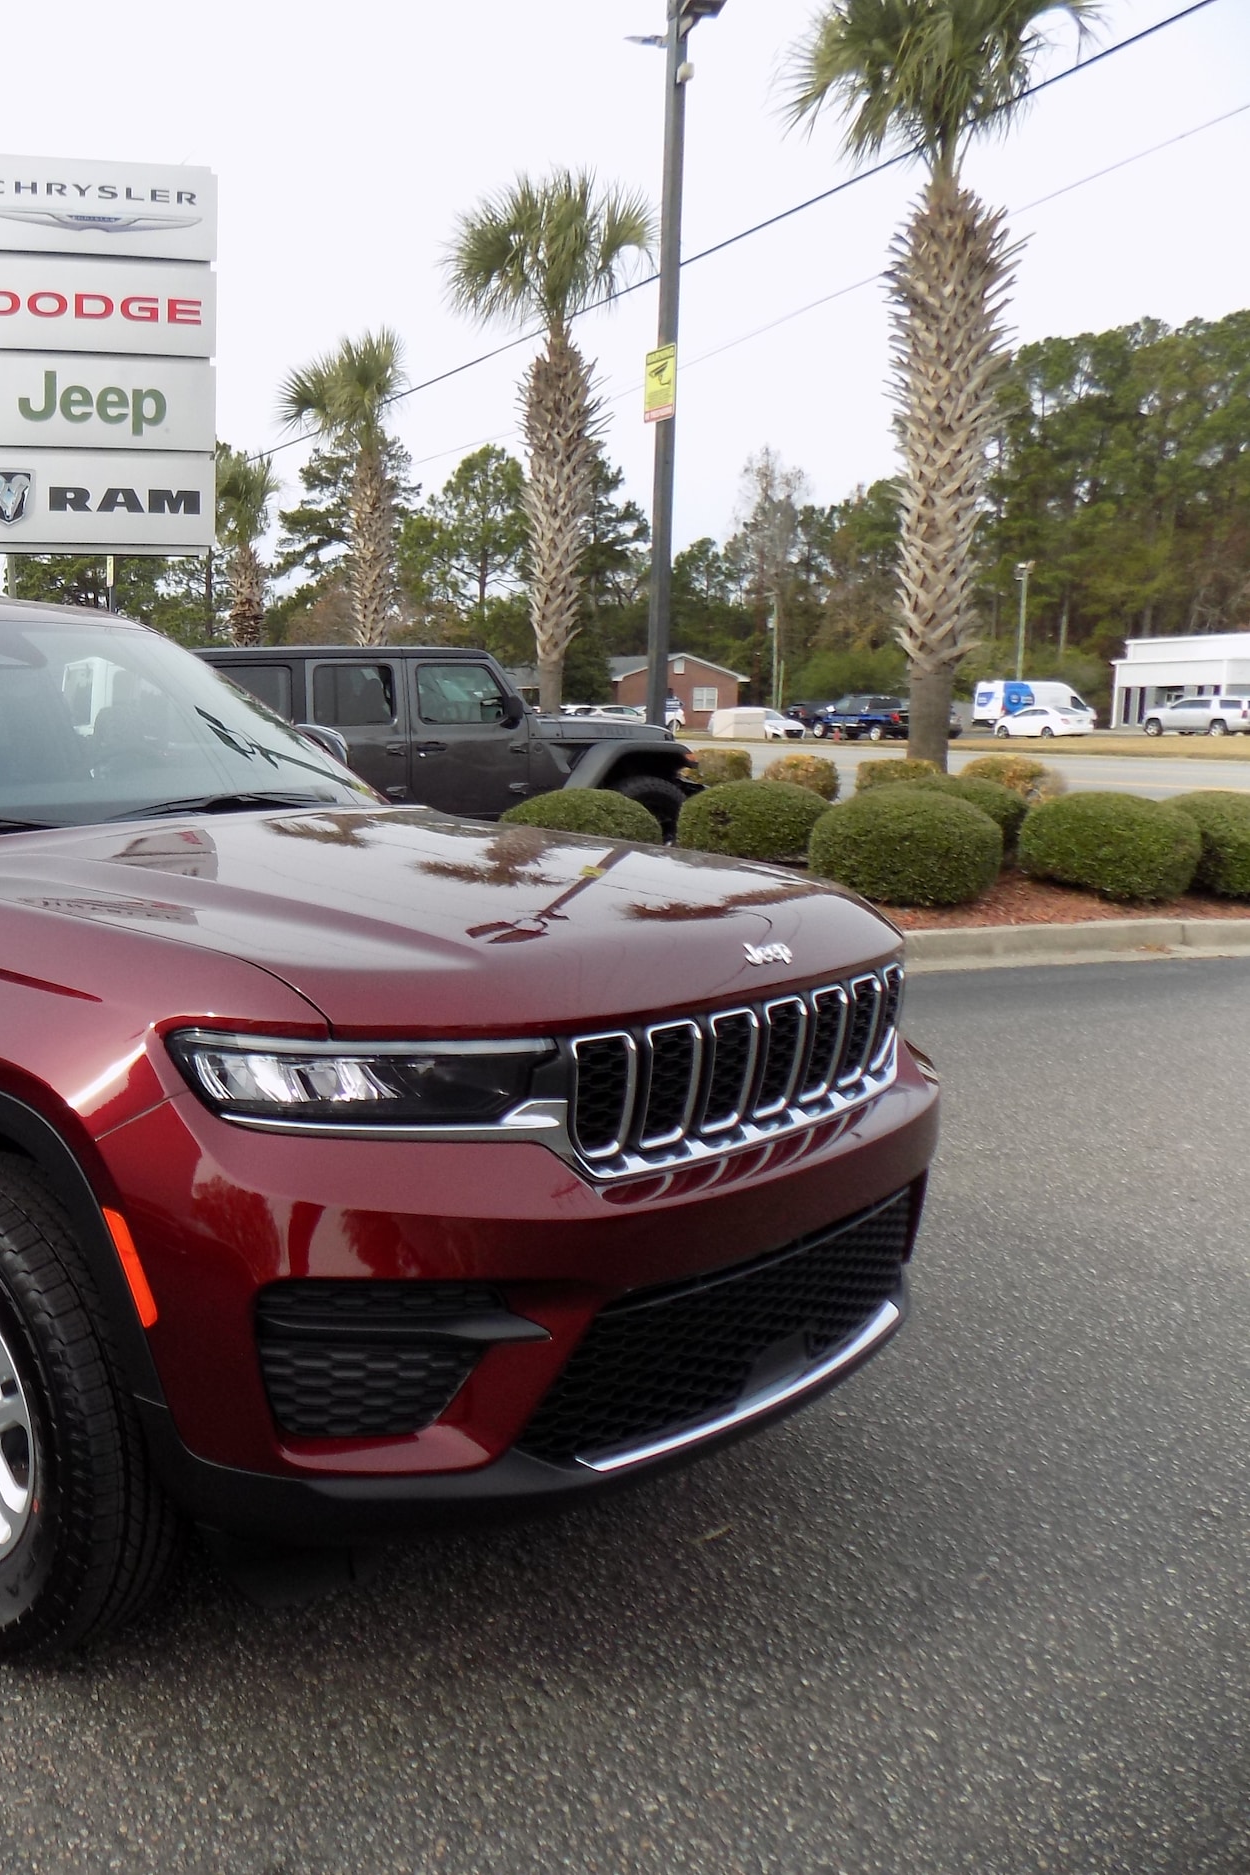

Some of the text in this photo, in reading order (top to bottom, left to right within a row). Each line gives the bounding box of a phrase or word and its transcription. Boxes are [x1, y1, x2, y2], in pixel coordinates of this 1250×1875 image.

[18, 370, 167, 436] Jeep
[49, 486, 200, 514] RAM
[742, 943, 793, 966] Jeep
